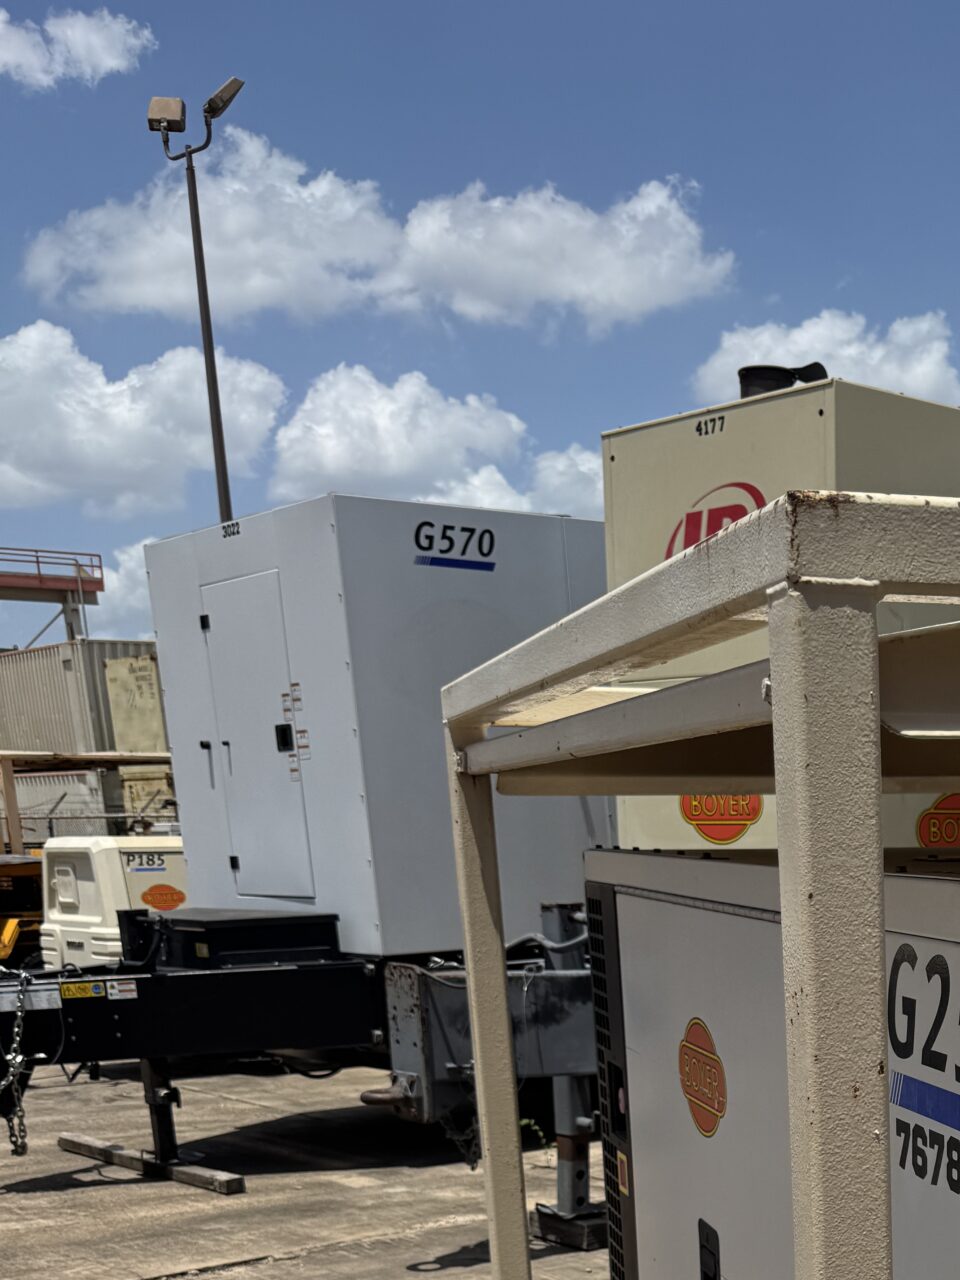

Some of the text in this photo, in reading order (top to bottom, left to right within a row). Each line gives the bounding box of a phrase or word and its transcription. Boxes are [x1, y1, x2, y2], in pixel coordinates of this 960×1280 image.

[695, 415, 725, 437] 4177
[222, 521, 240, 539] 3022
[414, 520, 495, 557] G570
[691, 793, 751, 816] BOYER
[126, 853, 165, 867] P185
